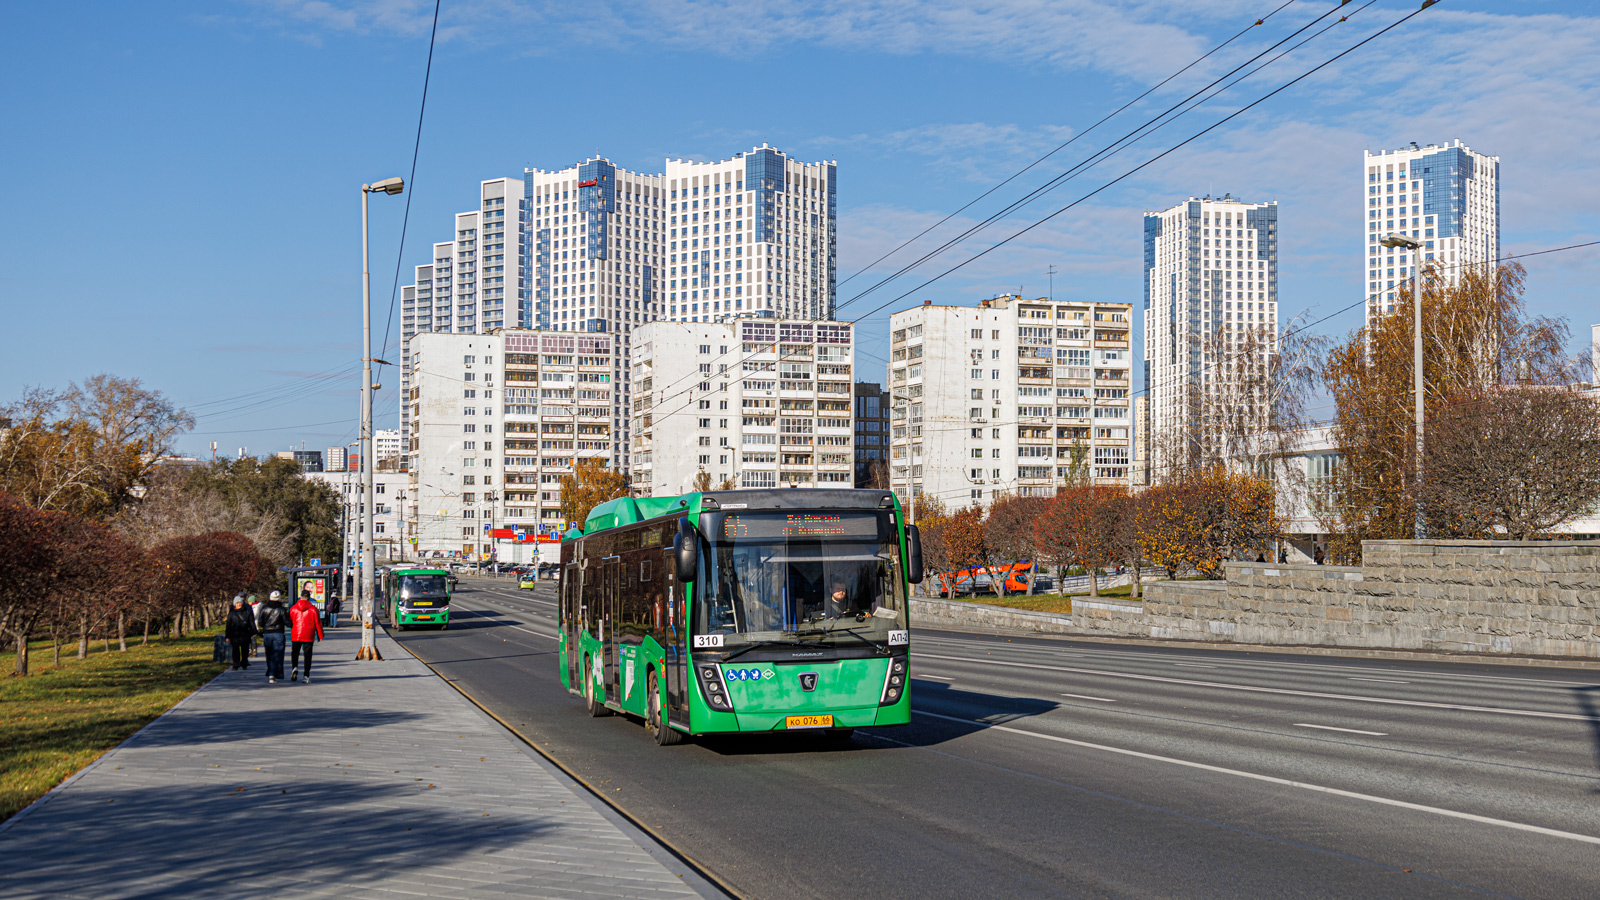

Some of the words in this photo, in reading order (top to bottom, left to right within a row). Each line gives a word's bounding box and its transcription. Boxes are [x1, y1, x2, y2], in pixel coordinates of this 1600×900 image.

[724, 515, 748, 537] 65
[698, 635, 718, 646] 310
[890, 632, 908, 643] АП-2
[802, 716, 818, 726] 076
